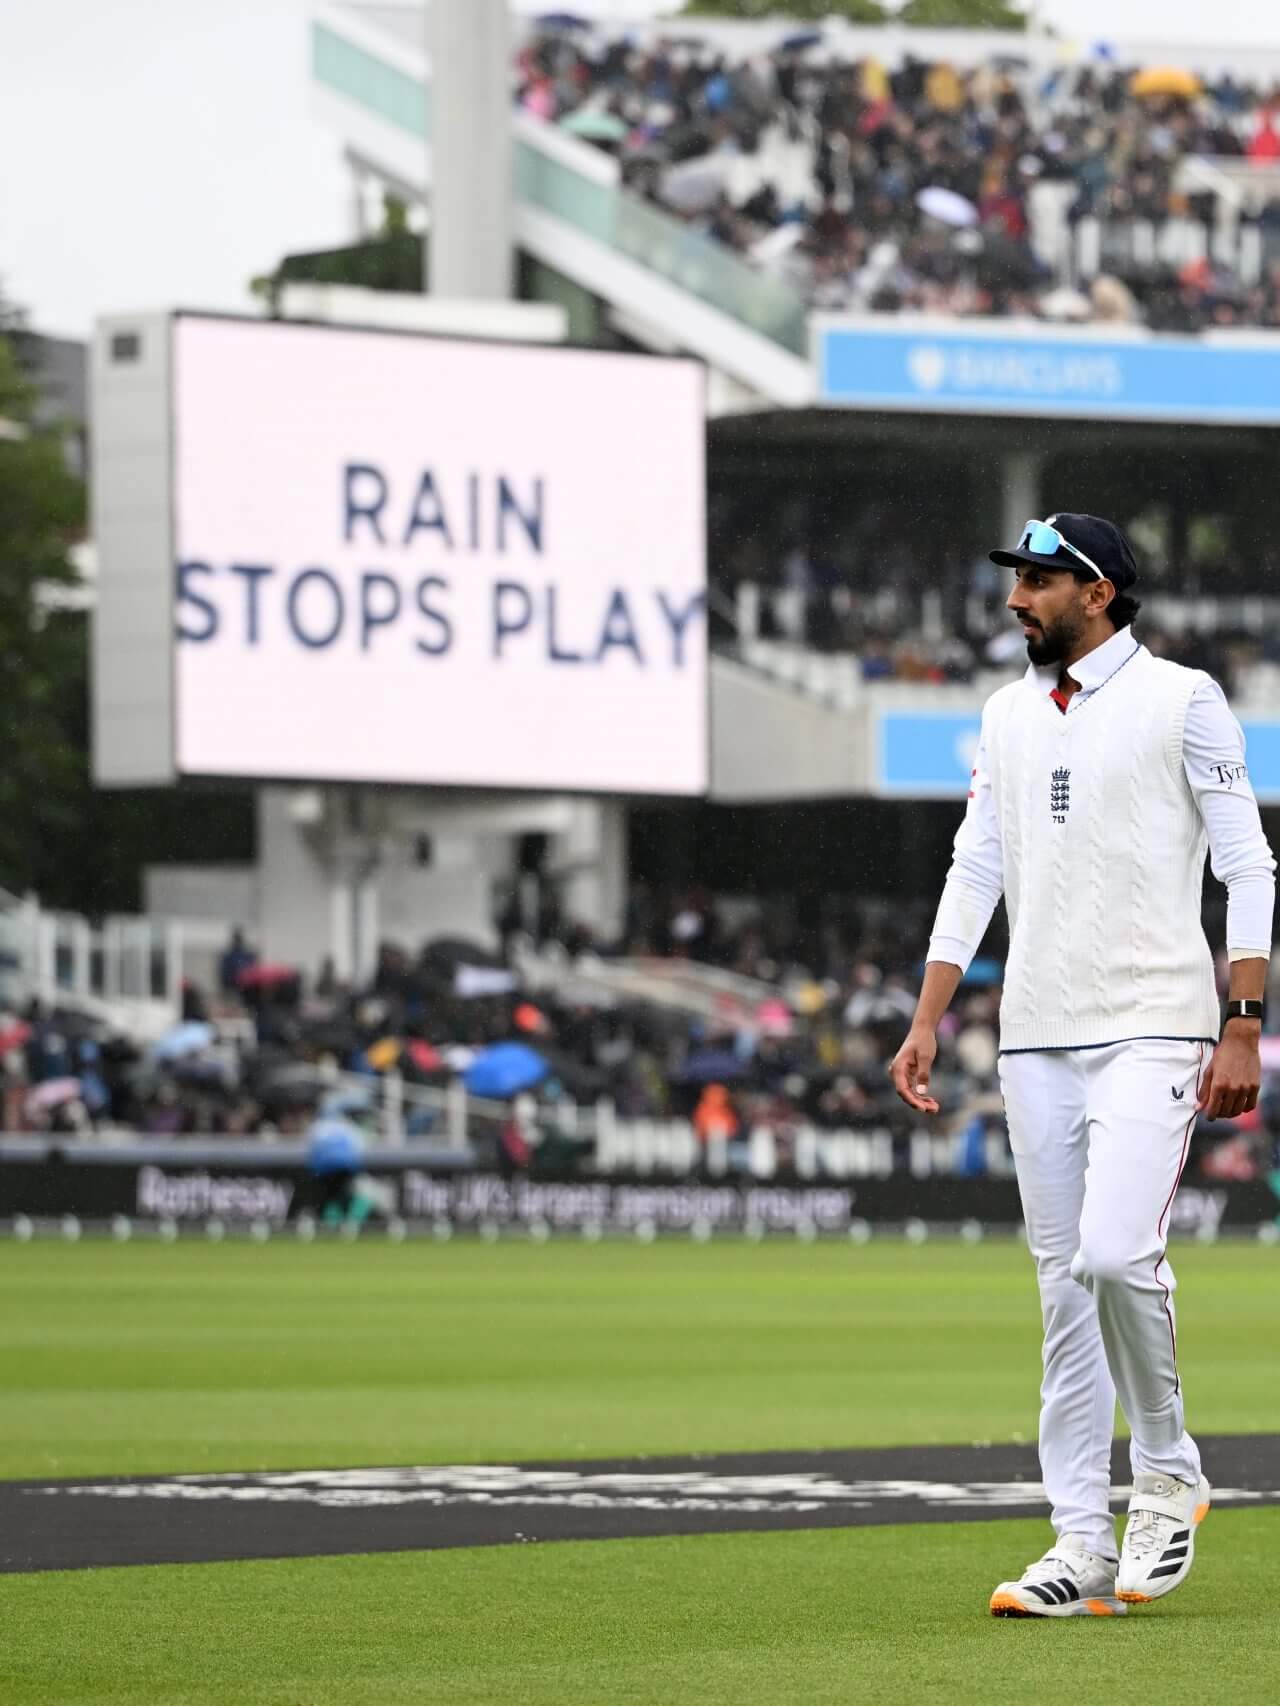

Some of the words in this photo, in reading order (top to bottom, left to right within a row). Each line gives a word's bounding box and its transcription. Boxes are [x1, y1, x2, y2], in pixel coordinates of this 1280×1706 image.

[341, 462, 544, 554] RAIN
[175, 560, 454, 656] STOPS
[493, 581, 705, 667] PLAY
[1053, 815, 1065, 824] 713
